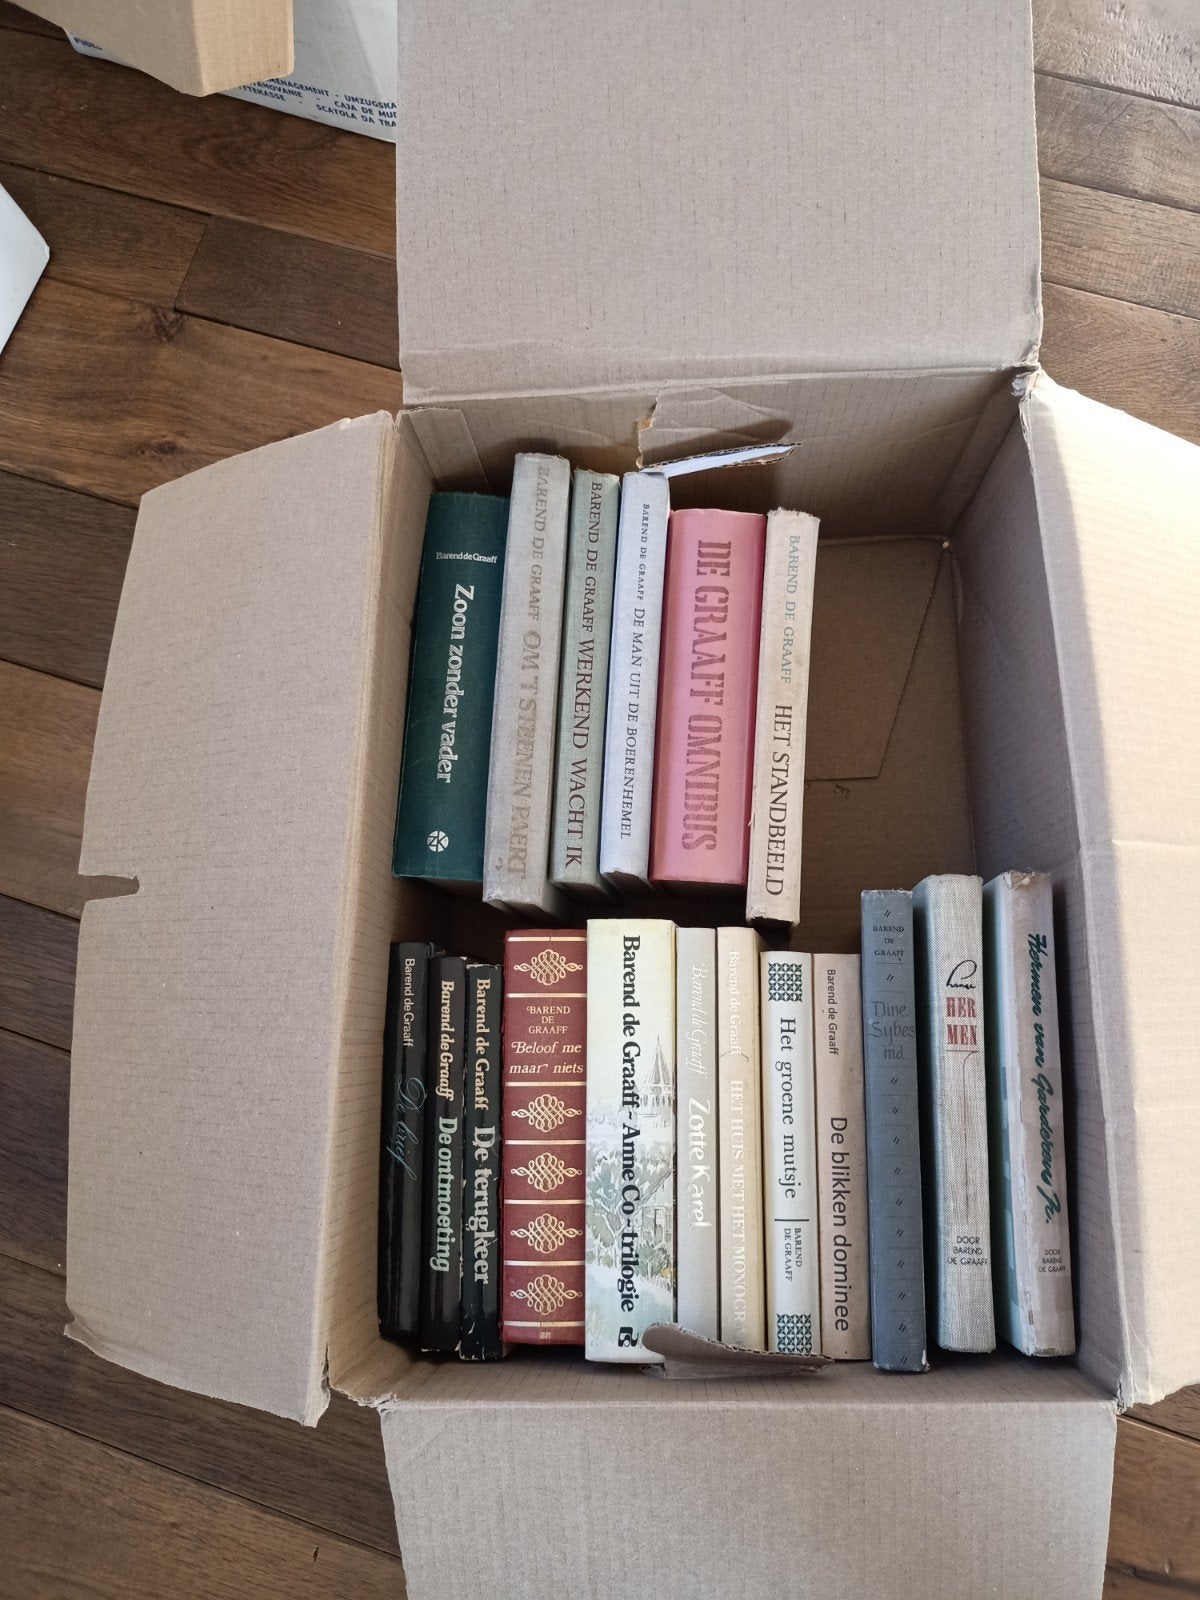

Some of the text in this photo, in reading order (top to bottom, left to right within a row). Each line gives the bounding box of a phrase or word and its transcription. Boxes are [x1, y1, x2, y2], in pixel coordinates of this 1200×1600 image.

[315, 104, 357, 120] SCATOLA
[361, 114, 375, 124] DA
[334, 100, 358, 112] CAJA
[361, 107, 374, 116] DE
[534, 464, 550, 532] BAREND
[436, 552, 498, 564] Barend de Graaff
[532, 536, 545, 560] DE
[527, 564, 543, 621] GRAAFF
[521, 630, 542, 672] OM
[620, 503, 650, 840] BAREND DE GRAAFF DE MAN UIT DE BOERENHEMEL
[437, 583, 475, 784] Zoon zonder vader
[565, 482, 603, 869] BAREND DE GRAAFF WERKEND WACHT IK
[681, 540, 732, 850] DE GRAAFF OMNIBUS
[765, 535, 800, 896] BAREND DE GRAAFF HET STANDBEELD
[872, 925, 905, 933] BAREND
[884, 937, 895, 945] DE
[622, 935, 641, 1007] Barend
[729, 951, 741, 995] Barend
[874, 949, 905, 958] GRAAFF
[1027, 933, 1048, 1016] Hermen
[402, 958, 416, 1048] Barend de Graaff
[692, 963, 708, 1014] Barend
[730, 998, 740, 1012] de
[871, 1001, 912, 1018] Dine
[946, 996, 977, 1018] HER
[526, 1006, 571, 1015] BAREND
[528, 1025, 568, 1034] GRAAFF
[541, 1016, 555, 1024] DE
[622, 1011, 641, 1037] de
[827, 969, 839, 1056] Barend de Graaff
[511, 1041, 582, 1054] Beloof me
[685, 1029, 708, 1079] Graaff
[730, 1014, 742, 1056] Graaff
[947, 1024, 978, 1046] MEN
[1033, 1022, 1046, 1069] van
[509, 1063, 584, 1074] maar niets
[622, 1041, 641, 1107] Graaff
[730, 1079, 743, 1114] HET
[775, 1017, 802, 1199] Het groene mutsje
[386, 1076, 428, 1181] De brief
[430, 980, 458, 1272] Barend de Graaff De ontmoeting
[465, 979, 496, 1285] Barend de Graaff De terugkeer
[688, 1097, 710, 1160] Zotte
[731, 1117, 744, 1159] HUIS
[1031, 1073, 1055, 1190] Garderen
[622, 1123, 641, 1181] Anne
[621, 1184, 640, 1215] Co
[689, 1164, 712, 1227] Karel
[731, 1164, 745, 1204] MET
[732, 1206, 745, 1242] HET
[830, 1117, 852, 1331] De blikken dominee
[956, 1235, 980, 1245] DOOR
[784, 1228, 793, 1282] DE GRAAFF
[794, 1227, 803, 1267] BAREND
[953, 1246, 983, 1255] BAREND
[617, 1228, 640, 1312] trilogie
